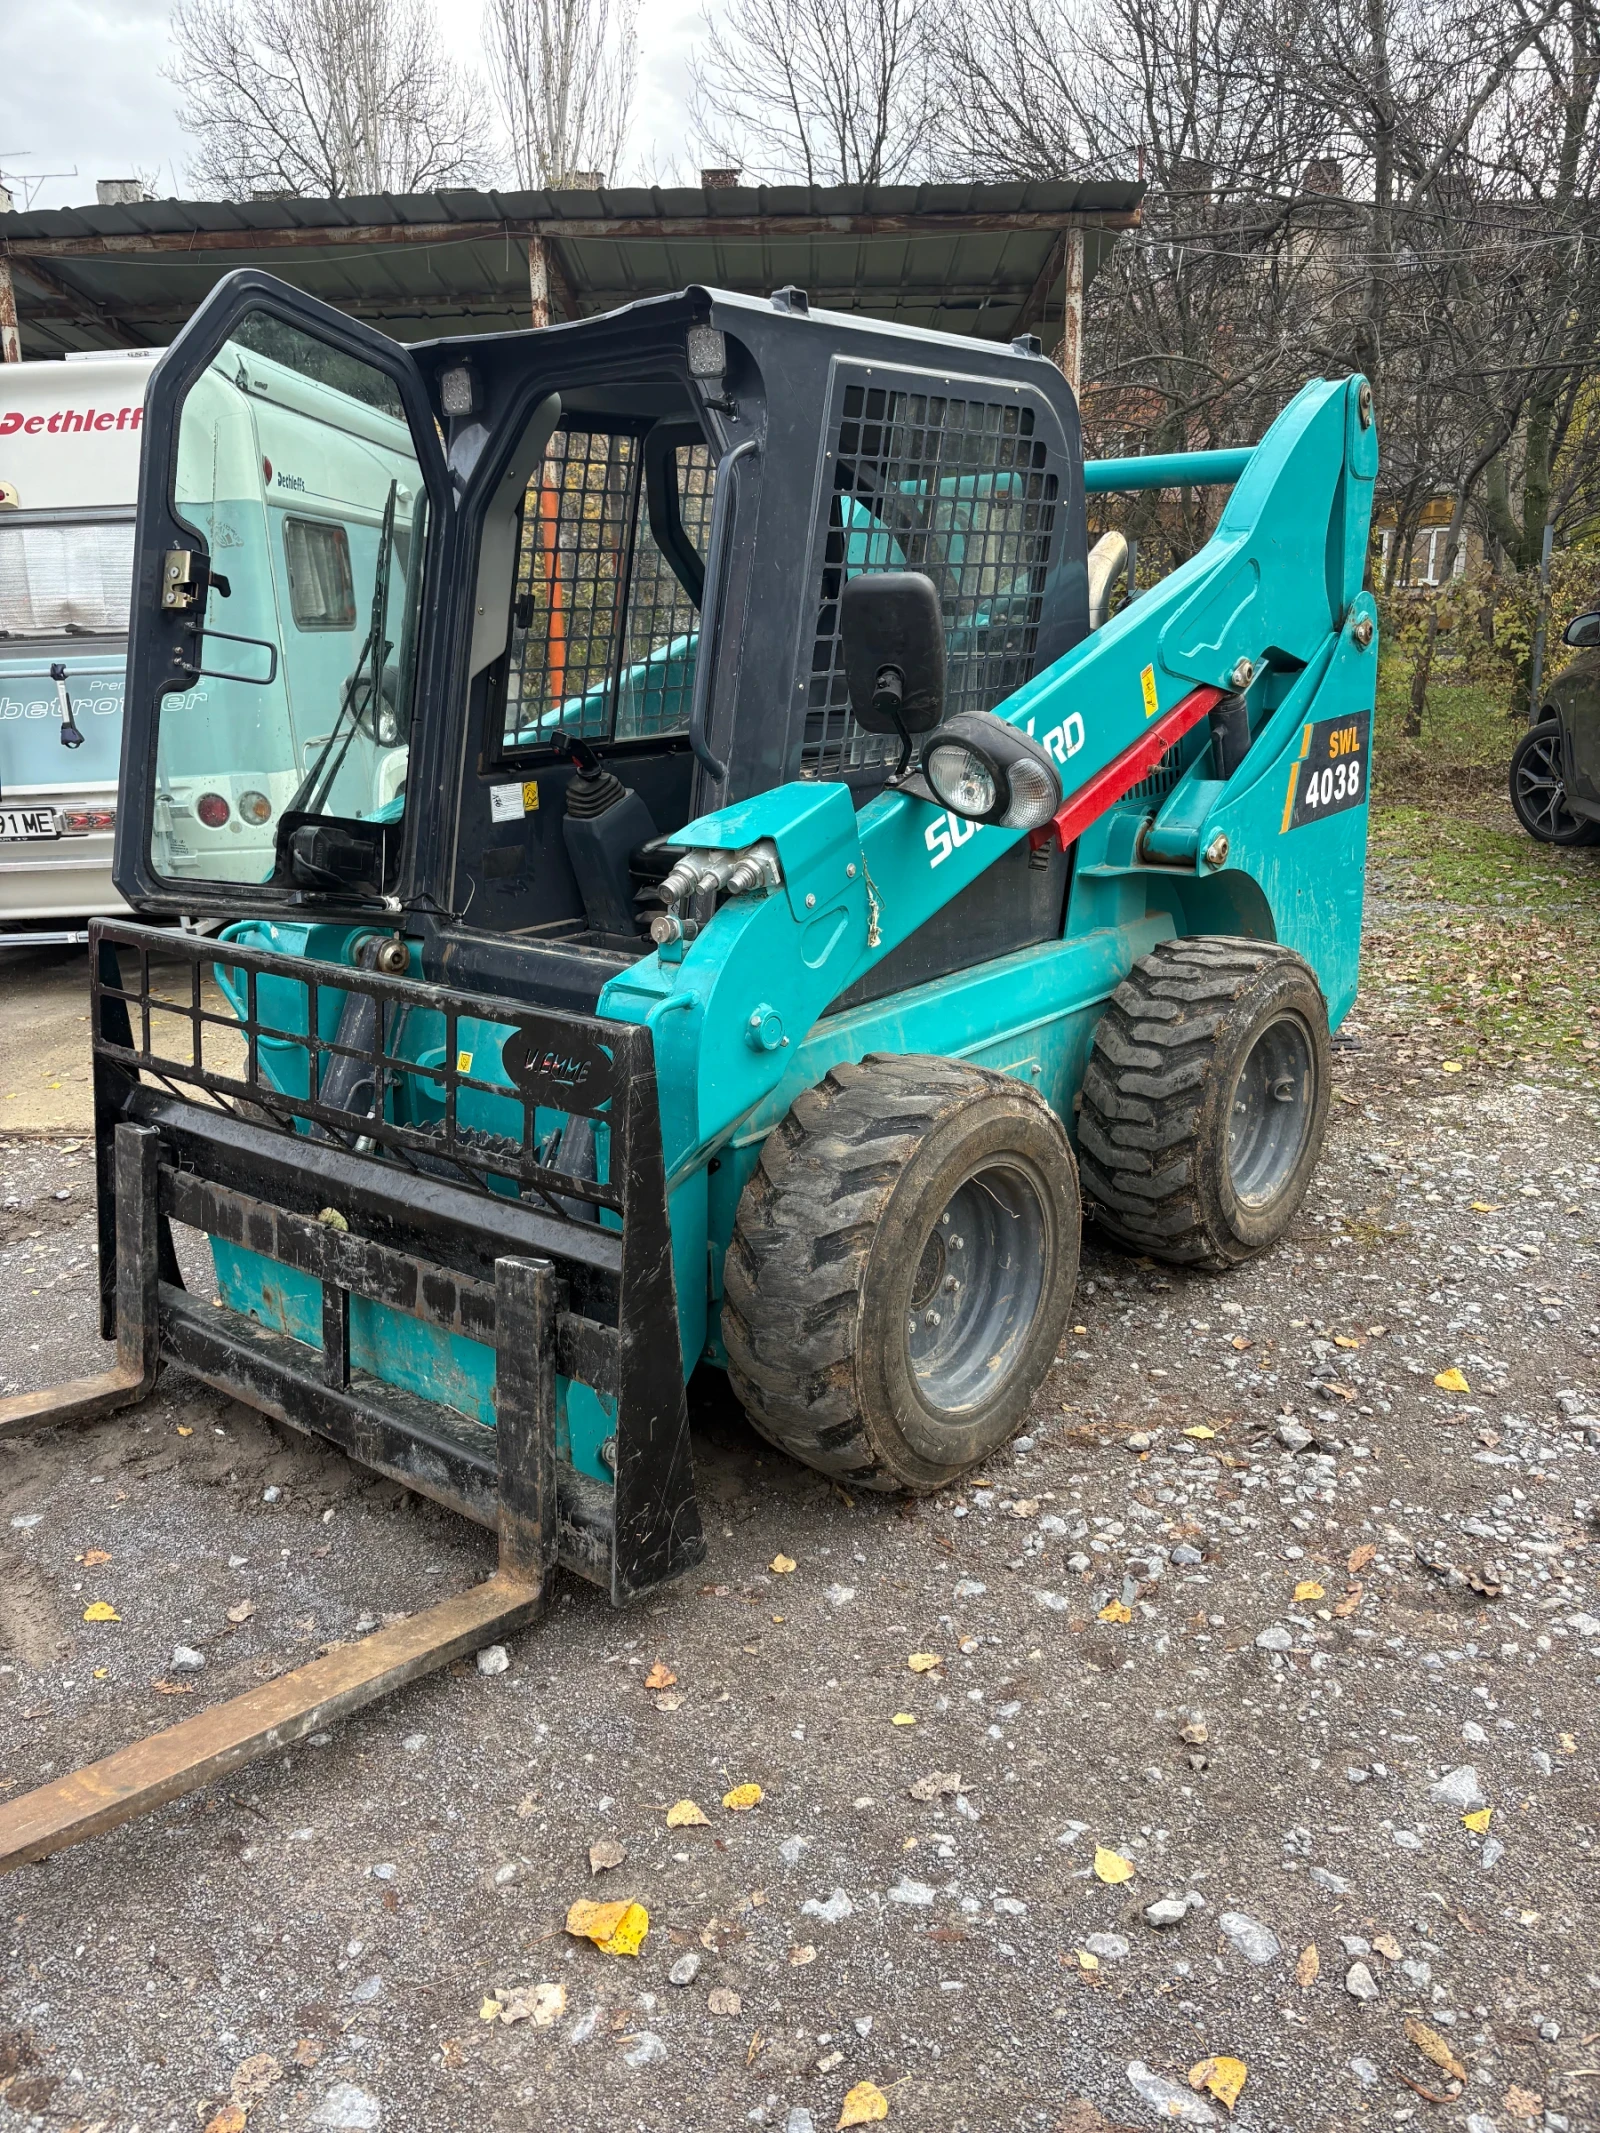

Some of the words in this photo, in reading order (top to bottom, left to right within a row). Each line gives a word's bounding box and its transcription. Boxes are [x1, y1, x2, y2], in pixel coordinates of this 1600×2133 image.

[1329, 726, 1360, 759] SWL
[924, 711, 1085, 870] SURD
[1305, 760, 1360, 808] 4038
[21, 813, 53, 833] ME
